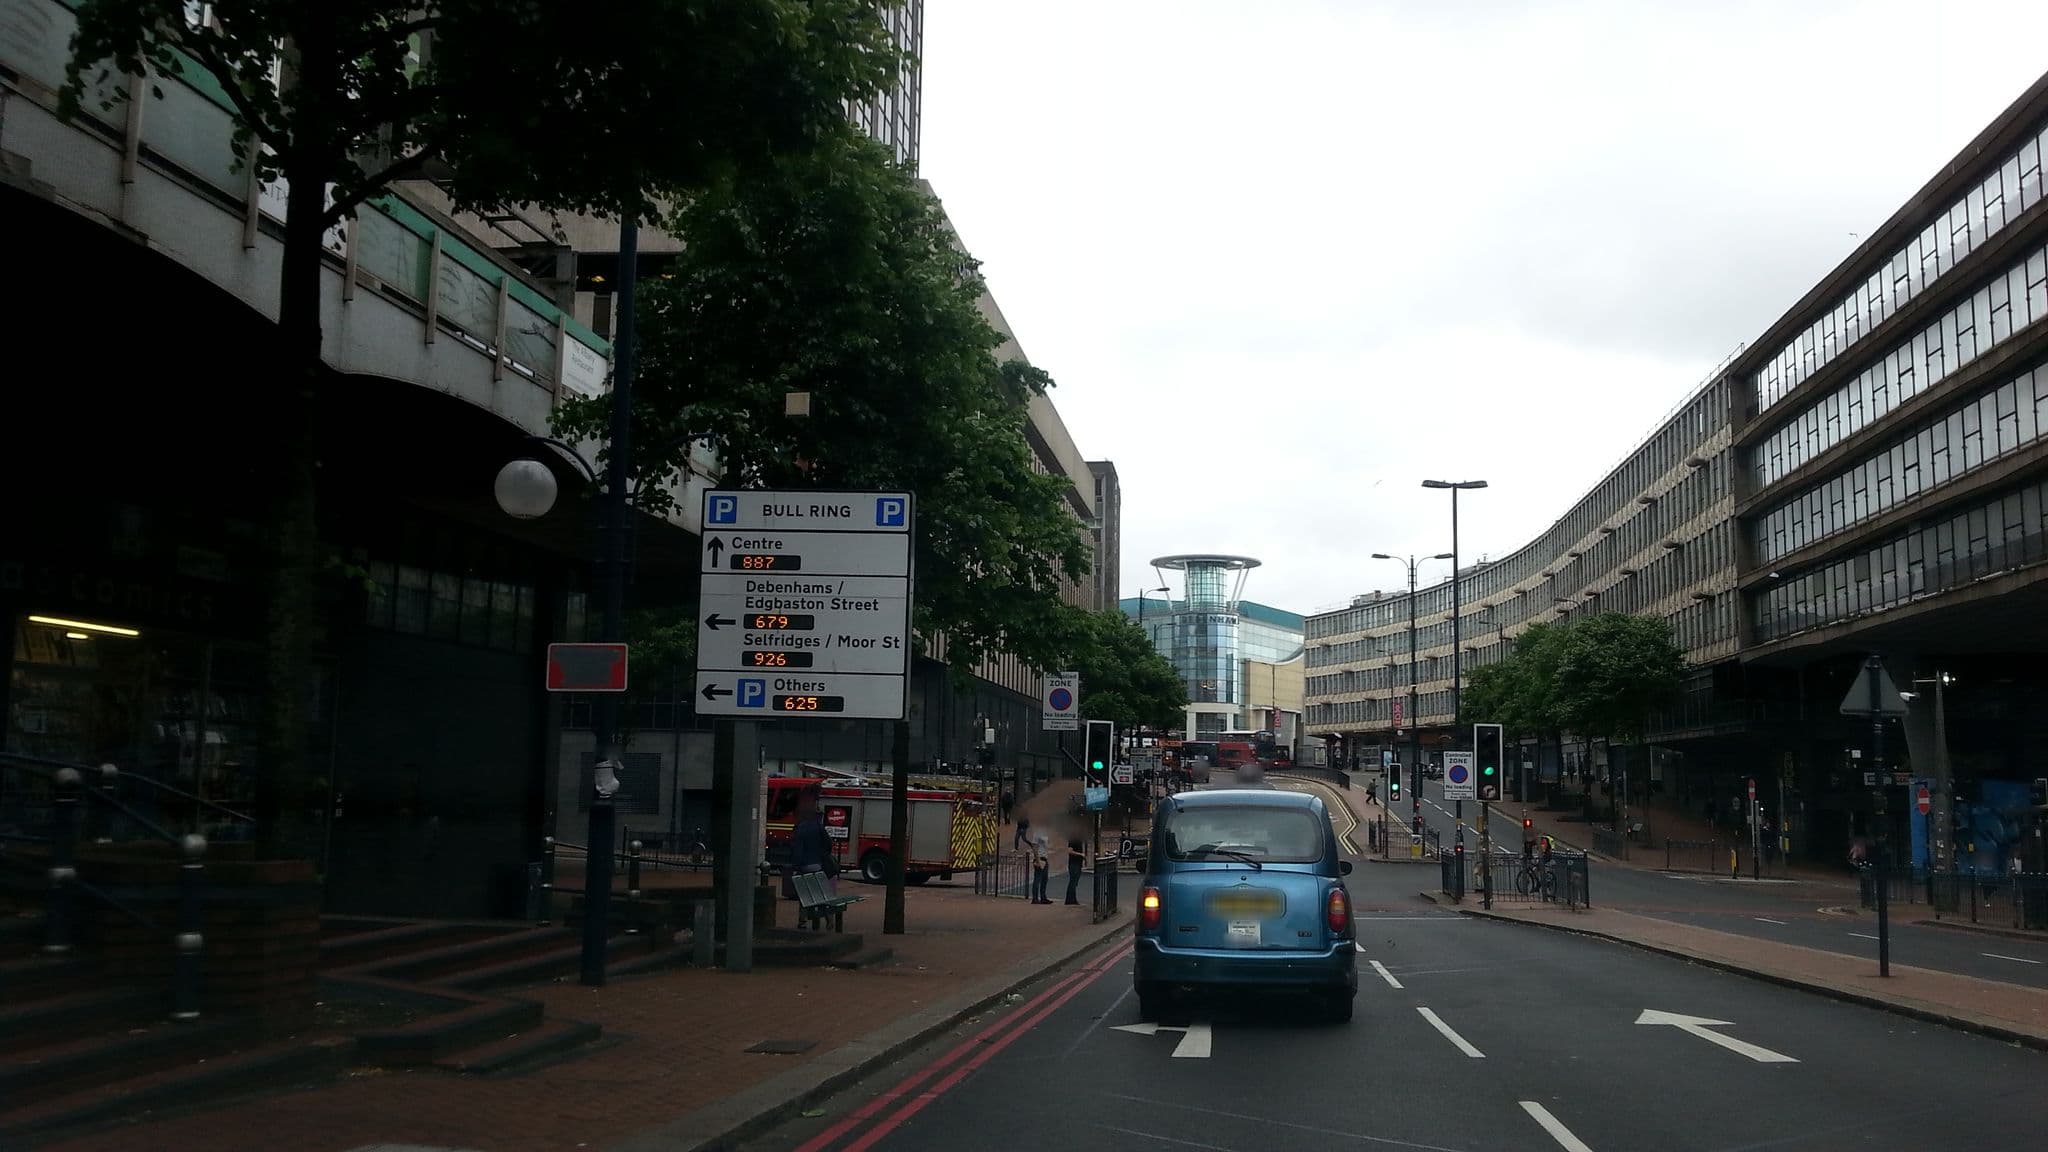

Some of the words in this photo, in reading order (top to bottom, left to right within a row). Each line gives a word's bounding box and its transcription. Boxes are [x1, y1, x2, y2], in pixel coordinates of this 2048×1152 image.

[716, 499, 734, 520] P
[763, 504, 804, 517] BULL
[810, 505, 852, 518] RING
[883, 502, 900, 524] P
[732, 537, 782, 550] Centre
[742, 556, 775, 569] 887
[746, 580, 832, 594] Debenhams
[838, 581, 844, 594] /
[745, 598, 824, 611] Edgbaston
[830, 598, 879, 611] Street
[756, 616, 788, 629] 679
[744, 634, 820, 648] Selfridges
[826, 634, 832, 648] /
[838, 635, 876, 648] Moor
[882, 636, 900, 649] St
[754, 653, 786, 666] 926
[774, 678, 826, 692] Others
[744, 682, 761, 704] P
[784, 698, 818, 710] 625
